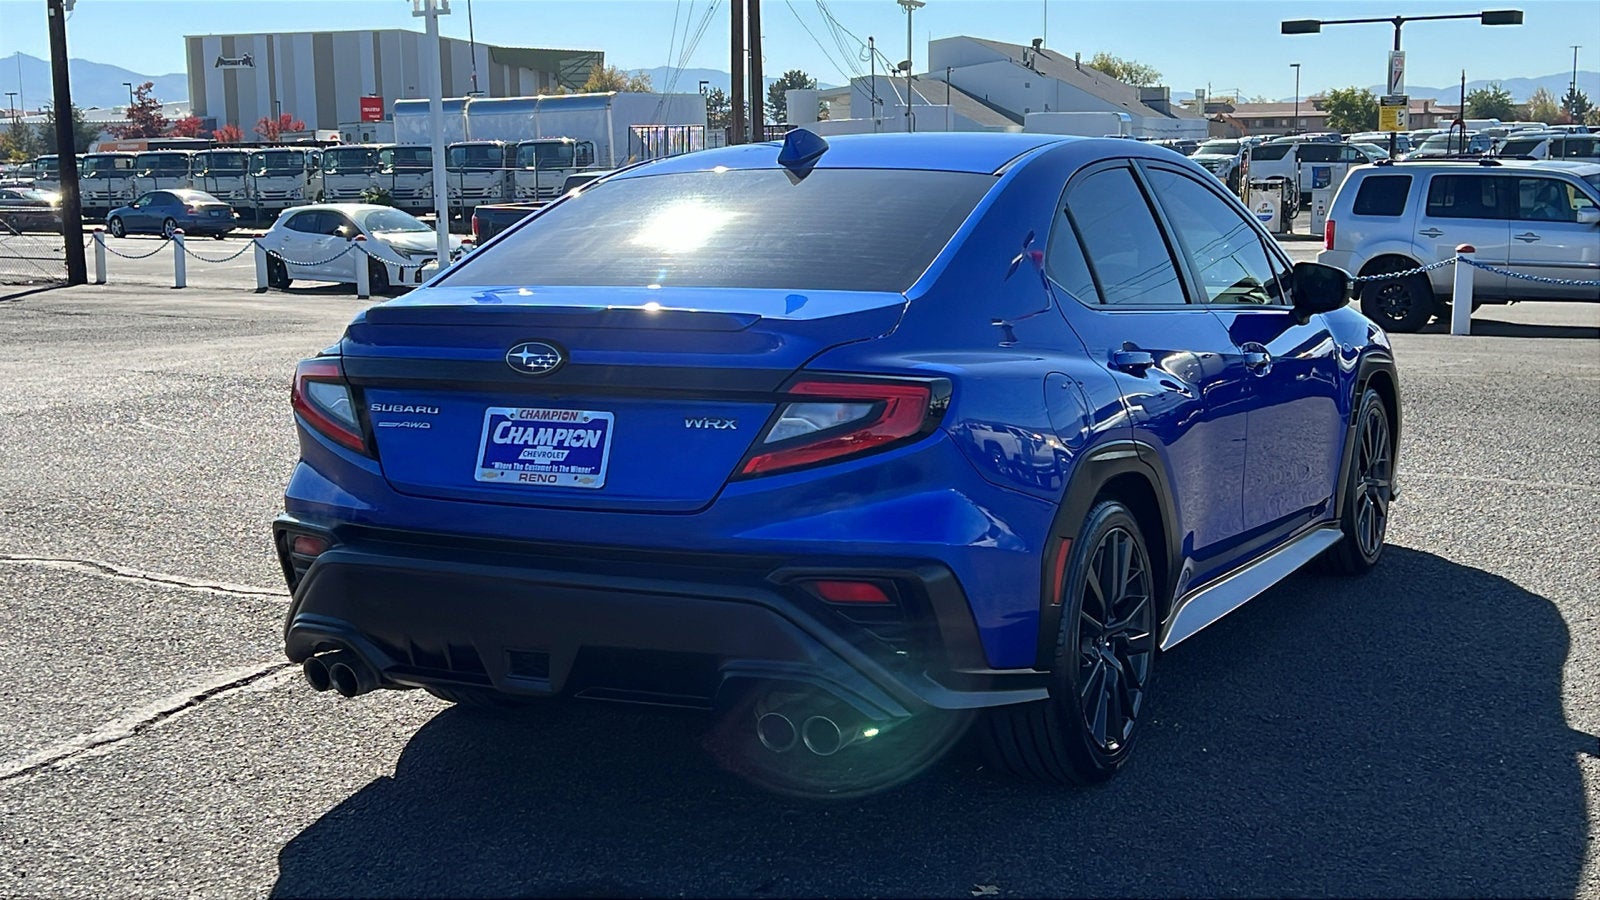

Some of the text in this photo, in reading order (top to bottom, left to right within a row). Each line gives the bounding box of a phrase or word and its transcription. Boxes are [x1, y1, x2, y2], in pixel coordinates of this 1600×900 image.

[370, 403, 439, 414] SUBARU
[519, 409, 578, 421] CHAMPION
[398, 421, 431, 429] AWD
[684, 418, 737, 429] WRX
[493, 421, 602, 448] CHAMPION
[522, 449, 566, 460] CHEVROLET
[513, 462, 524, 470] The
[518, 473, 557, 483] RENO
